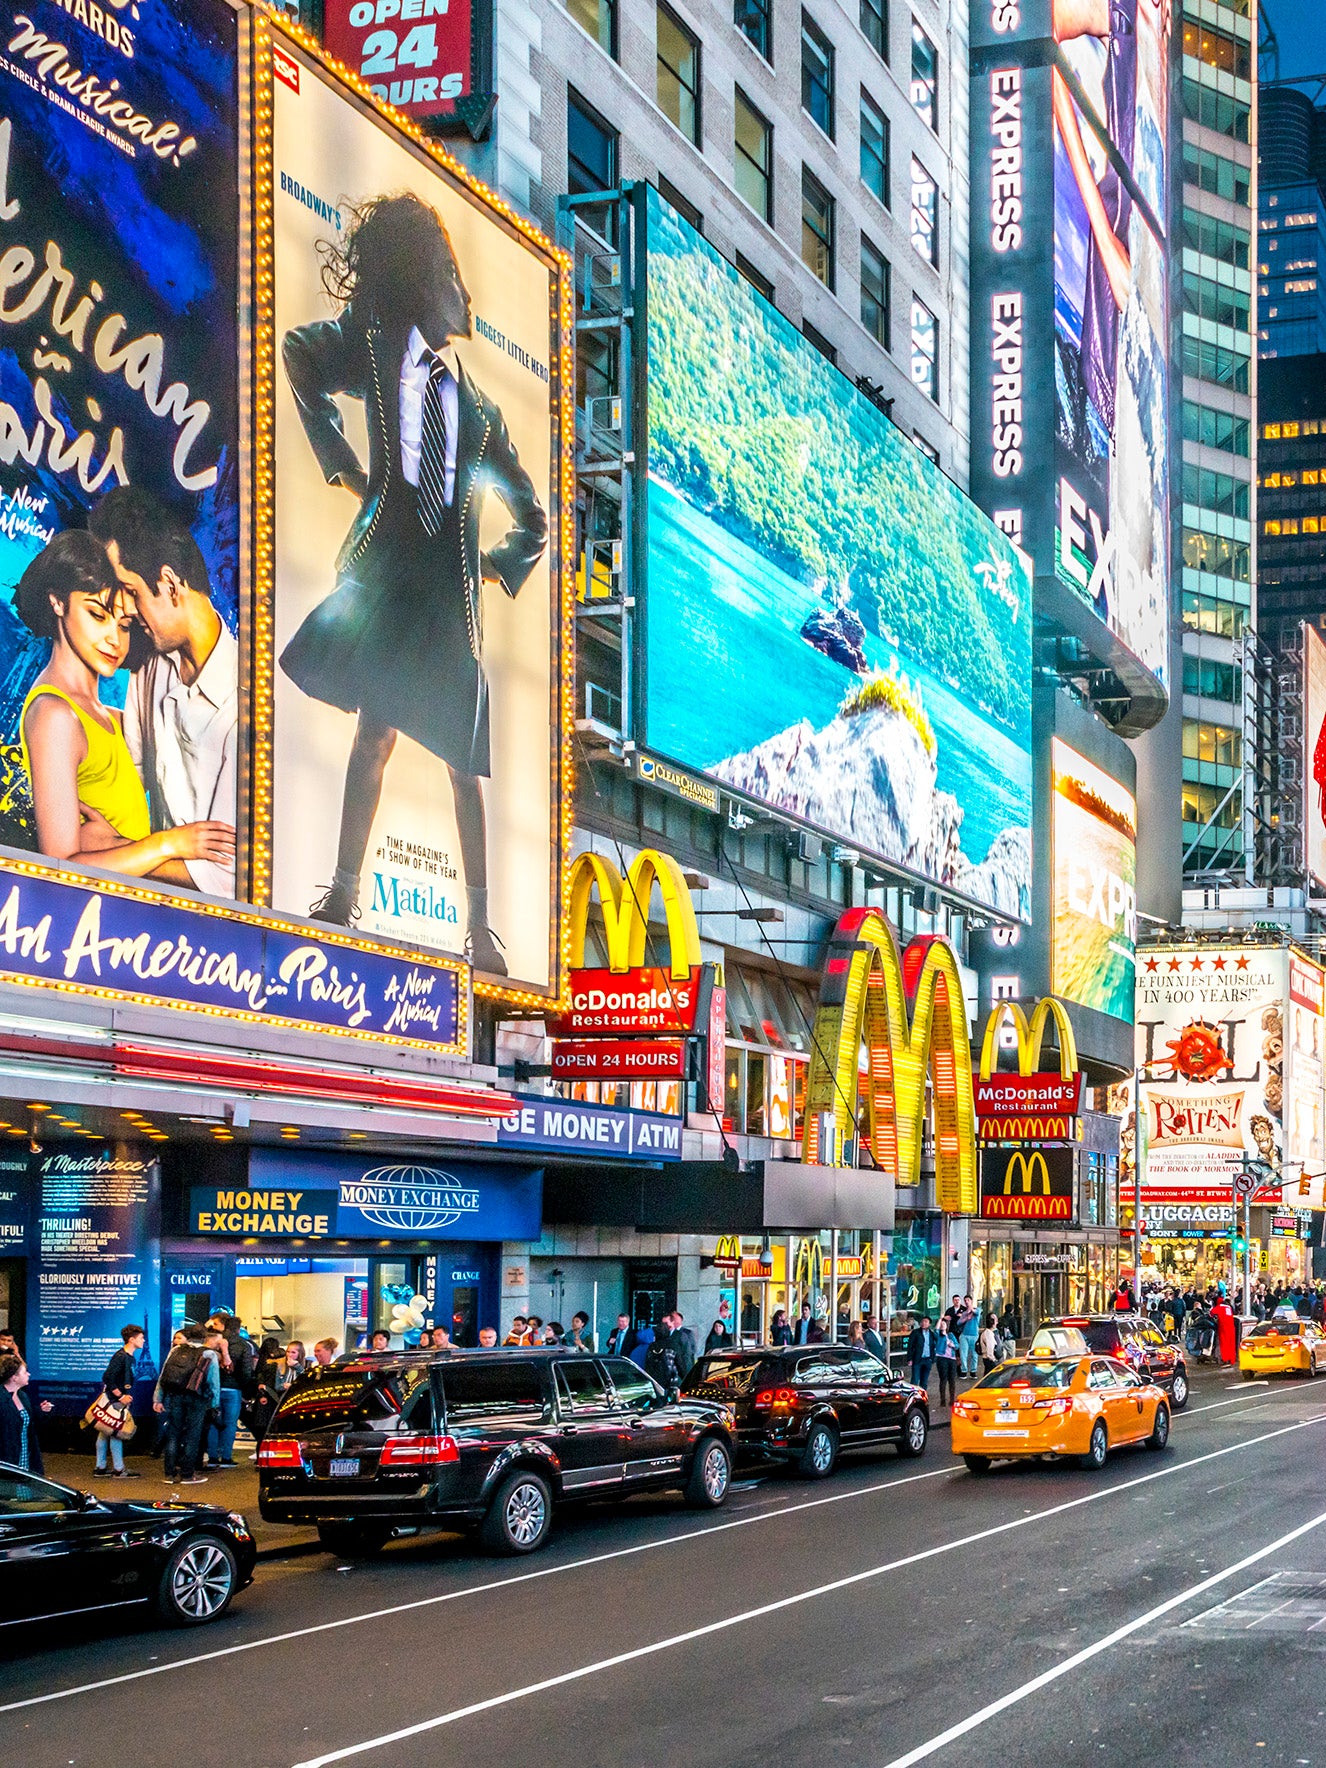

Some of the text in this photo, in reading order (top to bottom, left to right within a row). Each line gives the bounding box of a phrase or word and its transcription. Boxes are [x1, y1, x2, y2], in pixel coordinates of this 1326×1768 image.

[349, 0, 450, 27] OPEN
[361, 24, 439, 76] 24
[8, 14, 198, 168] Musical!
[371, 73, 463, 106] OURS
[10, 62, 40, 93] CIRCLE
[47, 88, 78, 117] DRAMA
[77, 110, 106, 138] LEAGUE
[105, 131, 137, 158] AWARDS
[991, 67, 1022, 253] EXPRESS
[281, 171, 342, 231] BROADWAY'S
[34, 335, 72, 374] in
[475, 314, 549, 384] BIGGEST LITTLE HERO
[992, 292, 1023, 477] EXPRESS
[9, 484, 50, 513] New
[376, 847, 458, 881] #1 SHOW OF THE YEAR
[386, 835, 449, 865] TIME MAGAZINE'S
[370, 871, 458, 924] Matilda
[0, 884, 373, 1026] An American in Paris
[384, 966, 436, 1002] A New
[1150, 973, 1275, 988] FUNNIEST MUSICAL
[568, 988, 690, 1011] cDonald's
[1144, 989, 1160, 1004] IN
[1164, 989, 1195, 1004] 400
[383, 1001, 441, 1033] Musical
[572, 1012, 665, 1027] Restaurant
[555, 1053, 679, 1067] OPEN 24 HOURS
[978, 1086, 1075, 1101] McDonald's
[993, 1102, 1058, 1112] Restaurant
[1160, 1096, 1231, 1108] SOMETHING
[543, 1111, 680, 1150] MONEY ATM
[1150, 1097, 1241, 1142] ROTTEN!
[216, 1191, 304, 1212] MONEY
[340, 1184, 480, 1209] MONEY EXCHANGE
[198, 1213, 329, 1234] EXCHANGE
[1139, 1206, 1233, 1222] LUGGAGE
[85, 1273, 142, 1286] INVENTIVE!
[170, 1274, 212, 1286] CHANGE
[426, 1256, 437, 1312] MONEY
[452, 1270, 480, 1283] CHANGE
[93, 1406, 123, 1428] TOMMY
